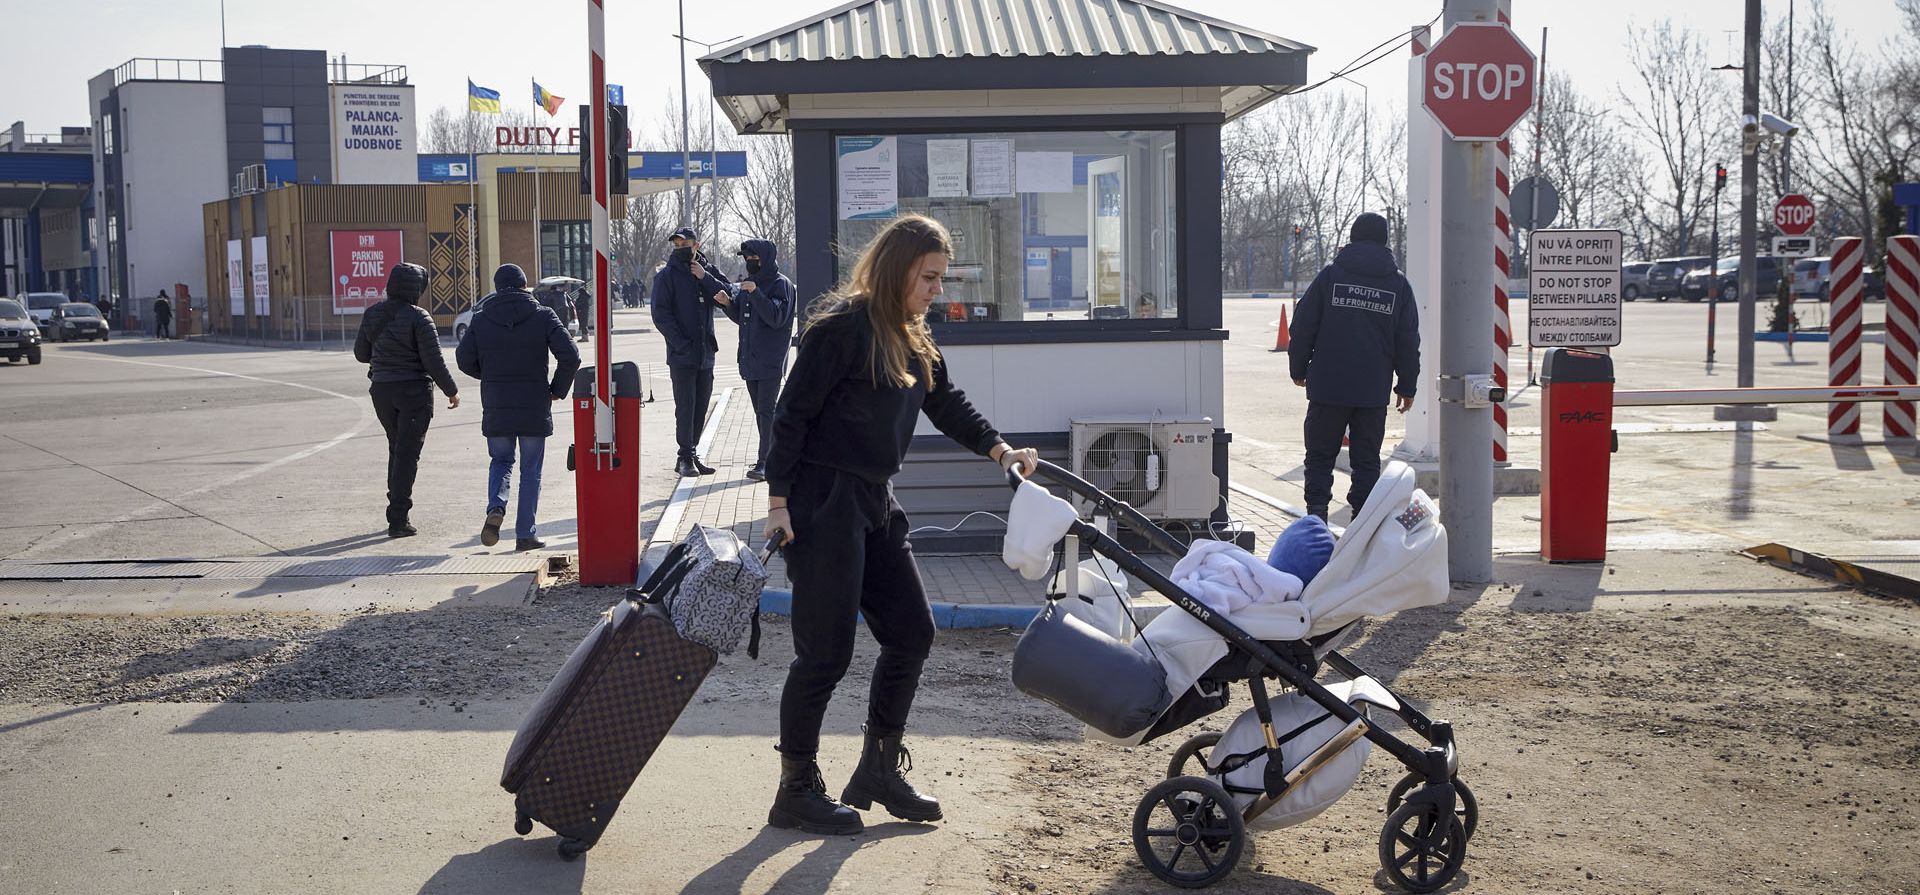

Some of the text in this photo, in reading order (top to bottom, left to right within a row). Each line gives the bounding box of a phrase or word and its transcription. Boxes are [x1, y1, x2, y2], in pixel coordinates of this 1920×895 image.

[1433, 62, 1525, 100] STOP
[346, 111, 403, 122] PALANCA-
[352, 125, 398, 136] MAIAKI-
[496, 127, 561, 147] DUTY
[345, 138, 402, 150] UDOBNOE
[1777, 205, 1813, 225] STOP
[359, 235, 375, 246] DFM
[1538, 239, 1554, 249] NU
[1557, 237, 1573, 249] VĂ
[352, 250, 383, 261] PARKING
[1539, 253, 1612, 265] ÎNTRE PILONI
[352, 261, 384, 277] ZONE
[1539, 278, 1612, 288] DO NOT STOP
[1333, 297, 1391, 312] DE FRONTIERĂ
[1532, 293, 1617, 304] BETWEEN PILLARS
[1530, 315, 1617, 326] НЕ ОСТАНАВЛИВАЙТЕСЬ
[1539, 333, 1612, 343] МЕЖДУ СТОЛБАМИ
[1180, 597, 1210, 621] STAR
